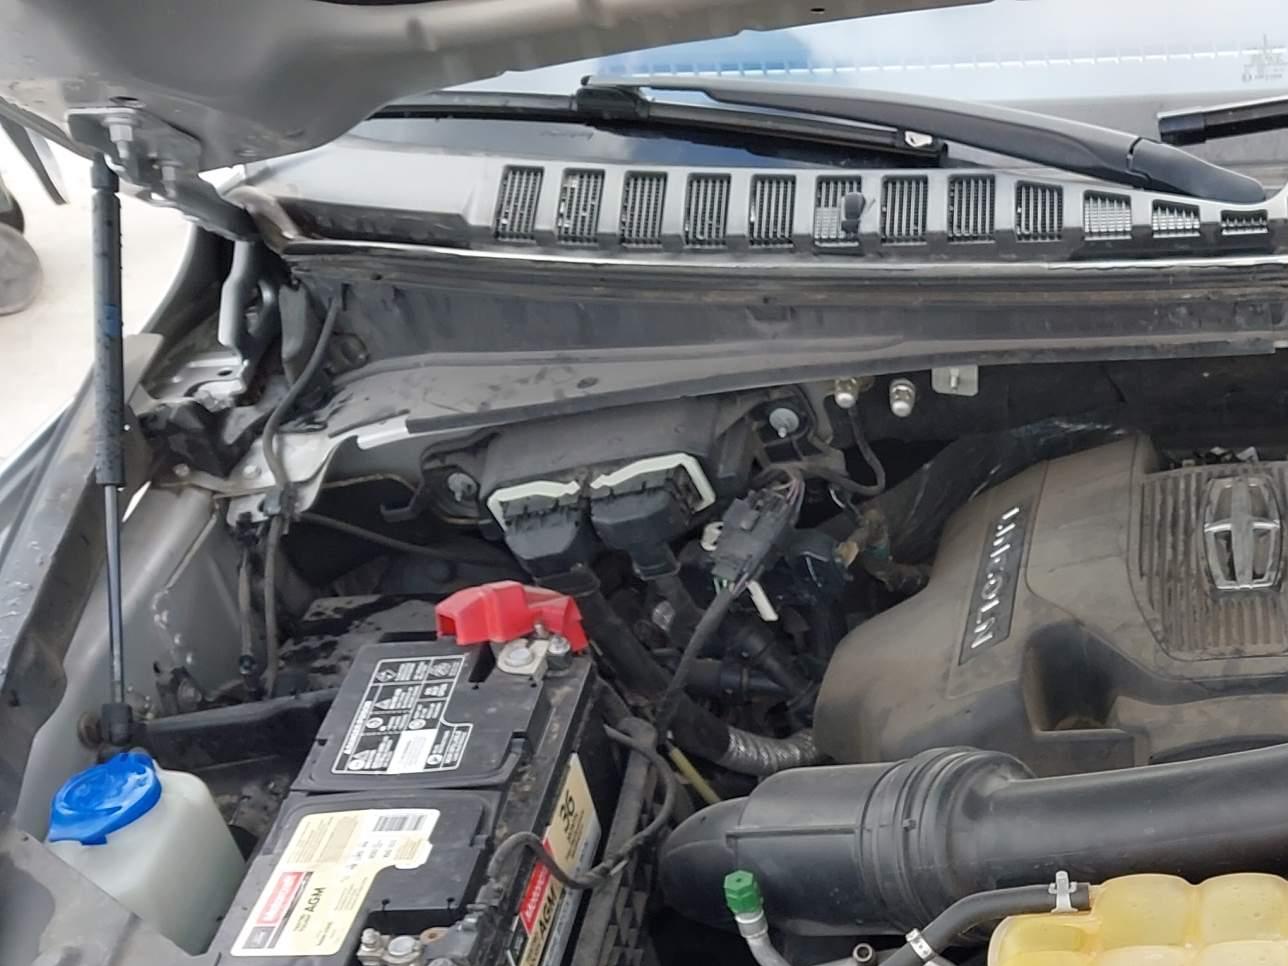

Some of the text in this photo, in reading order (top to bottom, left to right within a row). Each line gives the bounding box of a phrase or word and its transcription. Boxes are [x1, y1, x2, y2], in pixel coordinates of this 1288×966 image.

[559, 790, 575, 832] 36
[304, 886, 326, 913] AGM
[538, 885, 557, 937] AGM
